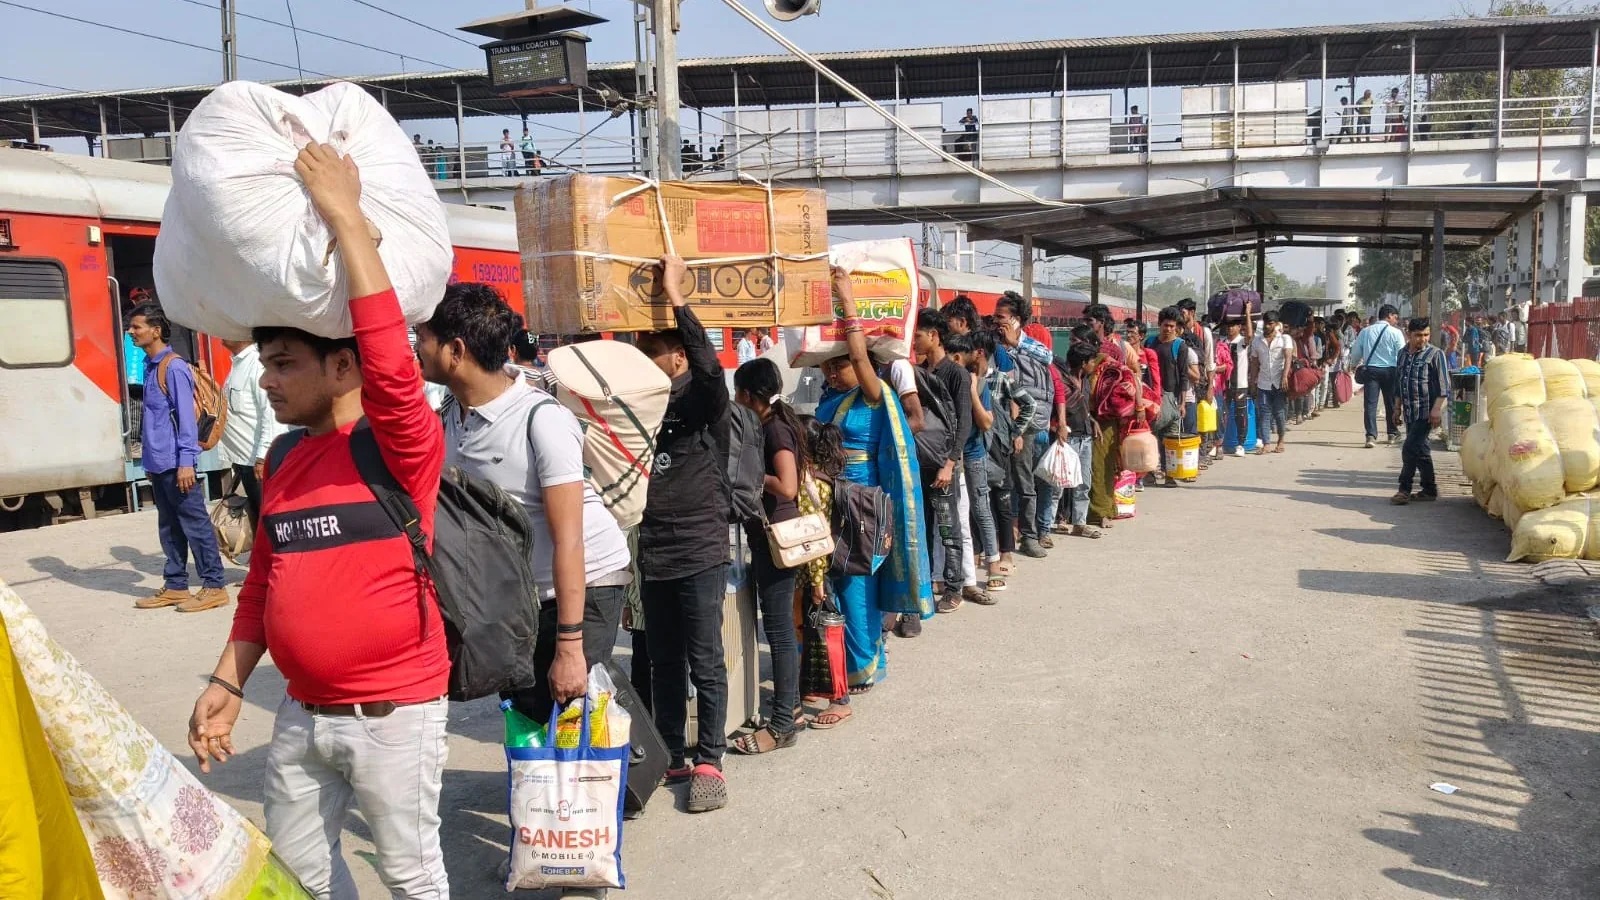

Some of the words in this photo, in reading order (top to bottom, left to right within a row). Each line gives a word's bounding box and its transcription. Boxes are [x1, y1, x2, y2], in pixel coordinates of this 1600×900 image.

[491, 46, 510, 55] TRAIN
[525, 40, 549, 50] COACH
[520, 826, 609, 849] GANESH
[541, 852, 584, 860] MOBILE
